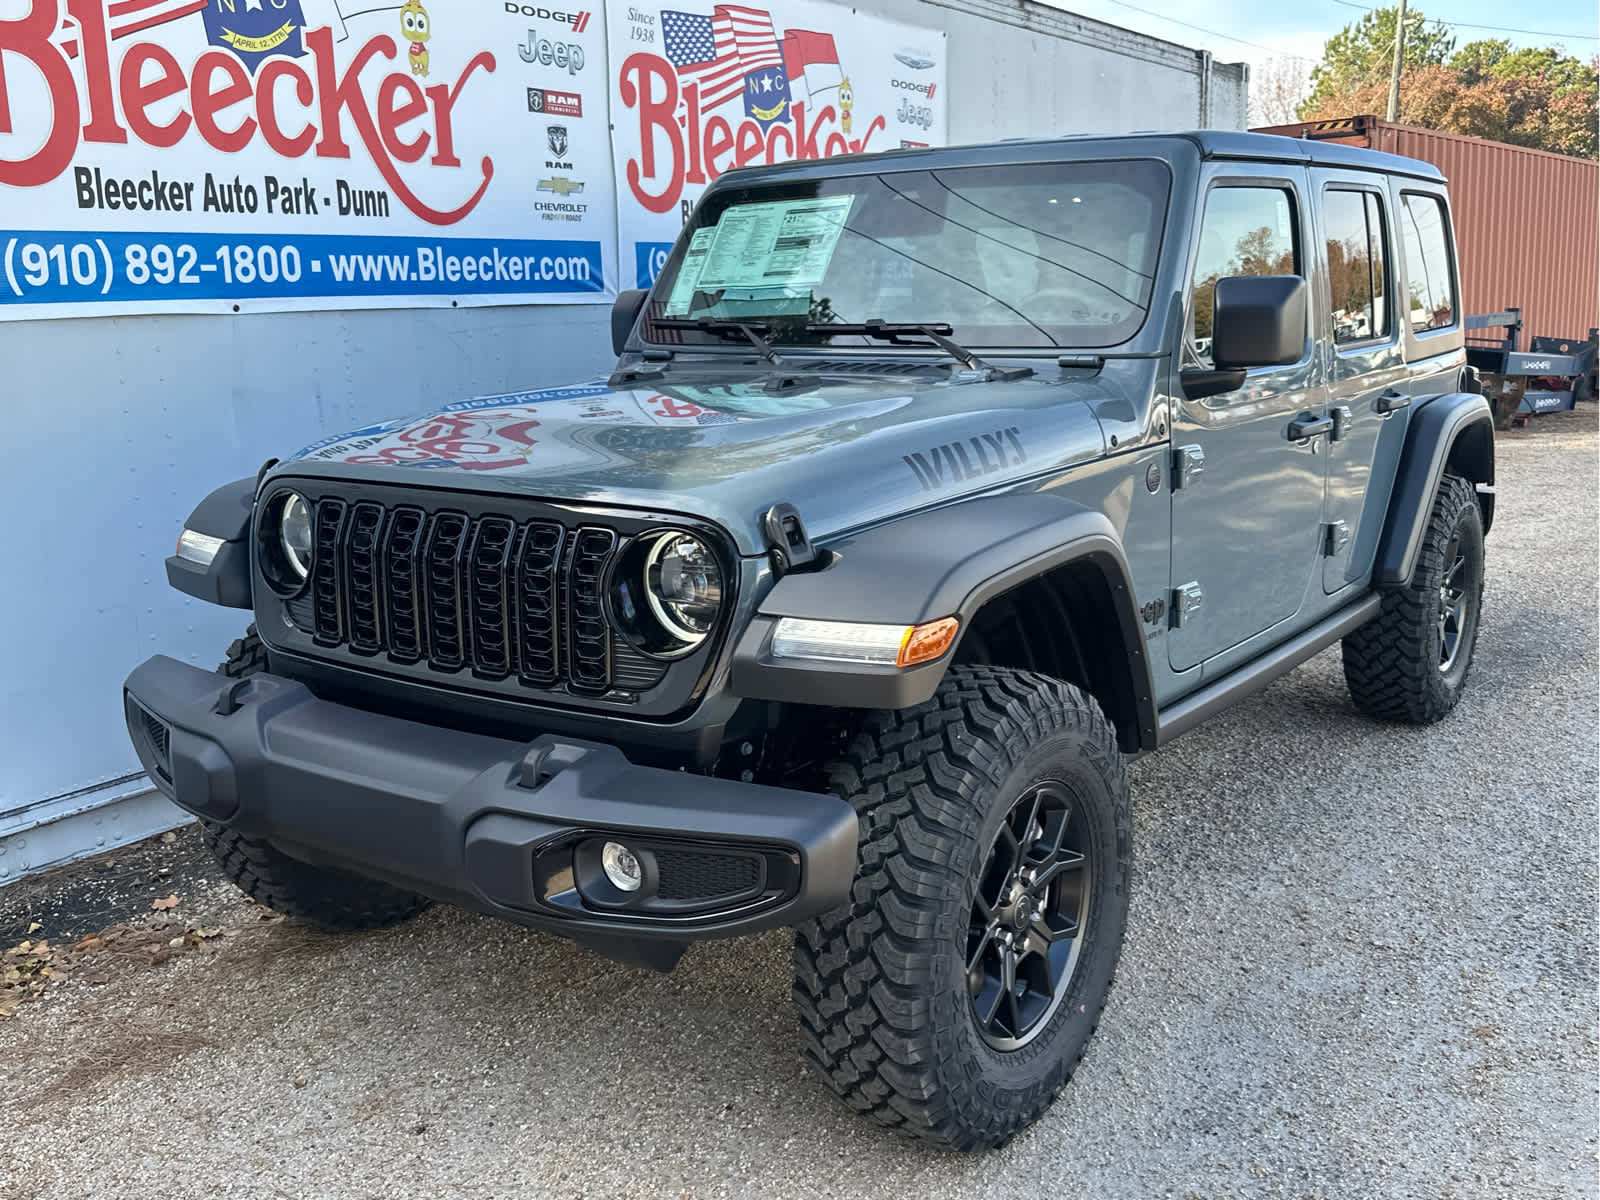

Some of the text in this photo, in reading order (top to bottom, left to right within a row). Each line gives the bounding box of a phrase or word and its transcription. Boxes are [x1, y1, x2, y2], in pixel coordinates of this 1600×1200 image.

[504, 2, 580, 25] DODGE
[627, 7, 655, 25] Since
[235, 38, 257, 48] APRIL
[631, 26, 655, 44] 1938
[518, 28, 584, 76] Jeep
[891, 79, 930, 93] DODGE
[547, 94, 578, 106] RAM
[897, 98, 934, 131] Jeep
[545, 161, 573, 170] RAM
[74, 166, 390, 217] Bleecker Auto Park Dunn
[534, 202, 588, 213] CHEVROLET
[4, 238, 590, 296] (910) 892-1800 www.Bleecker.com
[903, 426, 1027, 491] WILLYS
